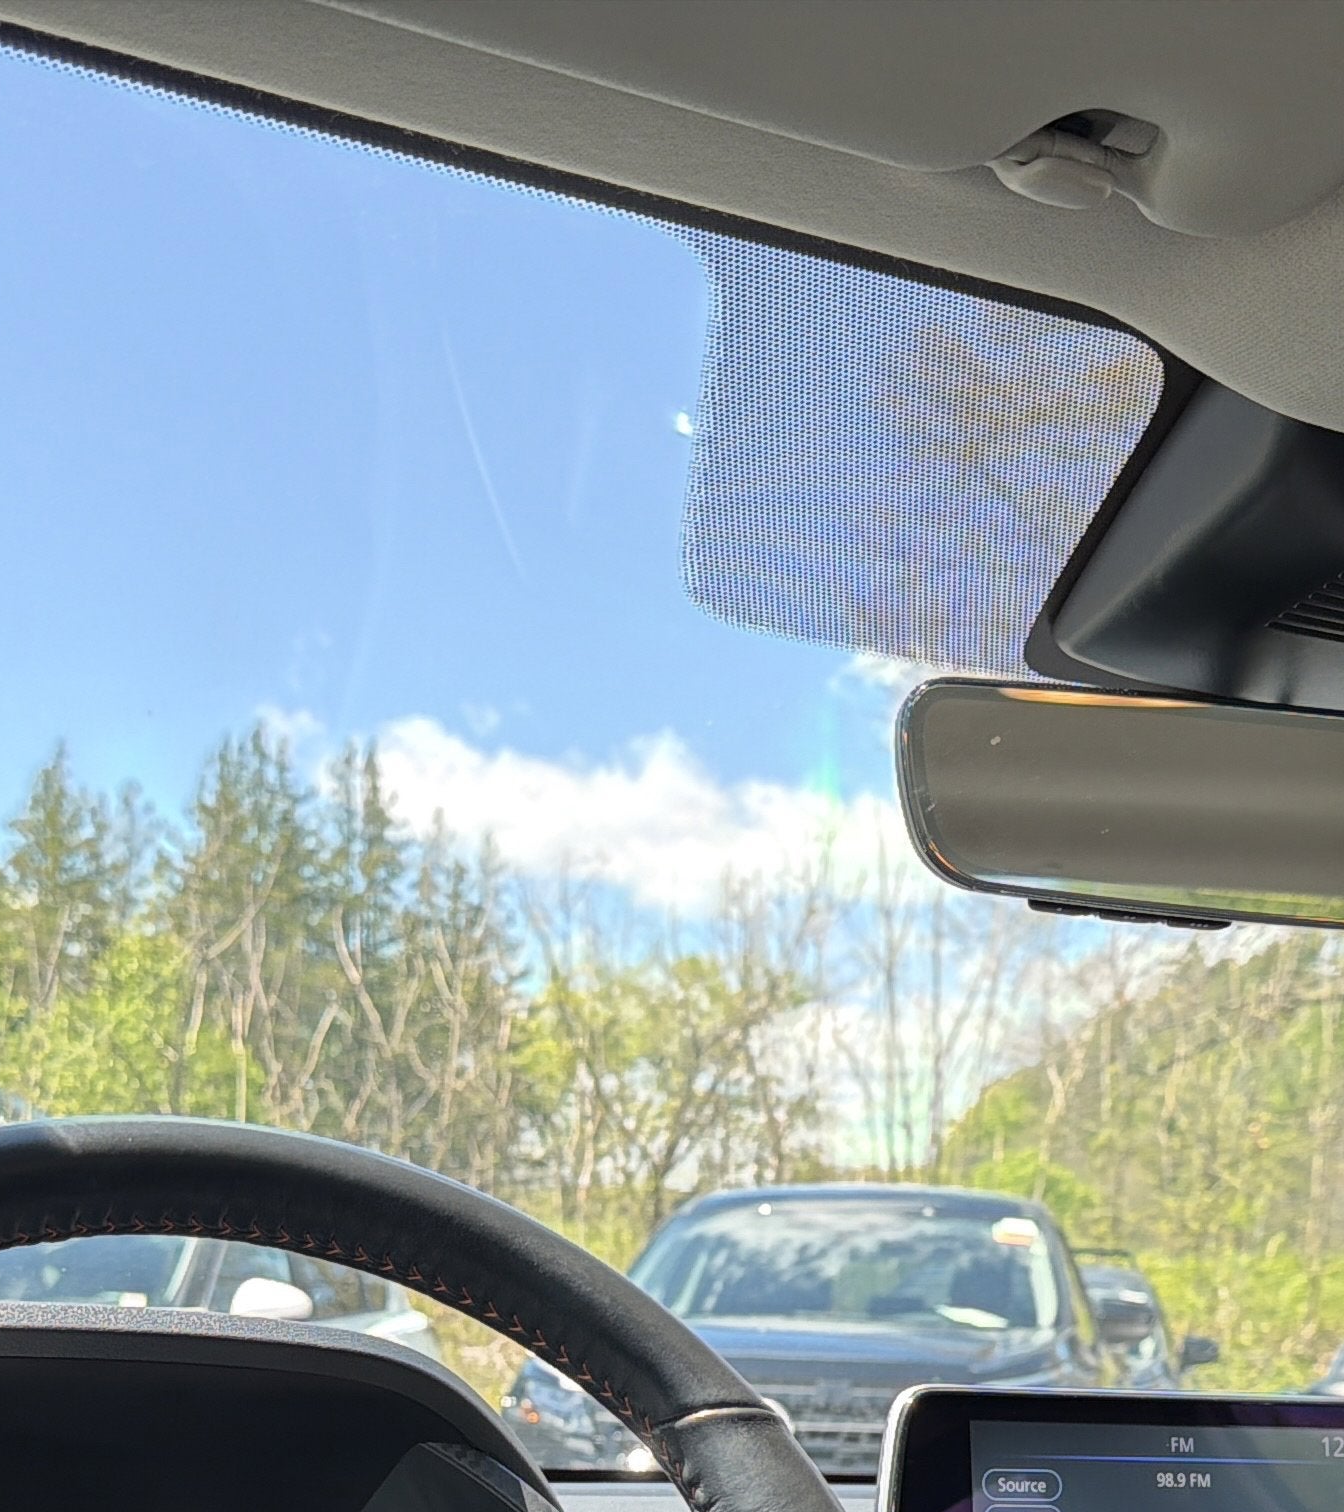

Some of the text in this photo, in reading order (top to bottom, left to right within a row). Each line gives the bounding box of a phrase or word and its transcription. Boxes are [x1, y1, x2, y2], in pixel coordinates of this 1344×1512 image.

[1170, 1437, 1194, 1453] FM
[997, 1477, 1047, 1493] Source
[1156, 1472, 1211, 1488] 98.9 FM
